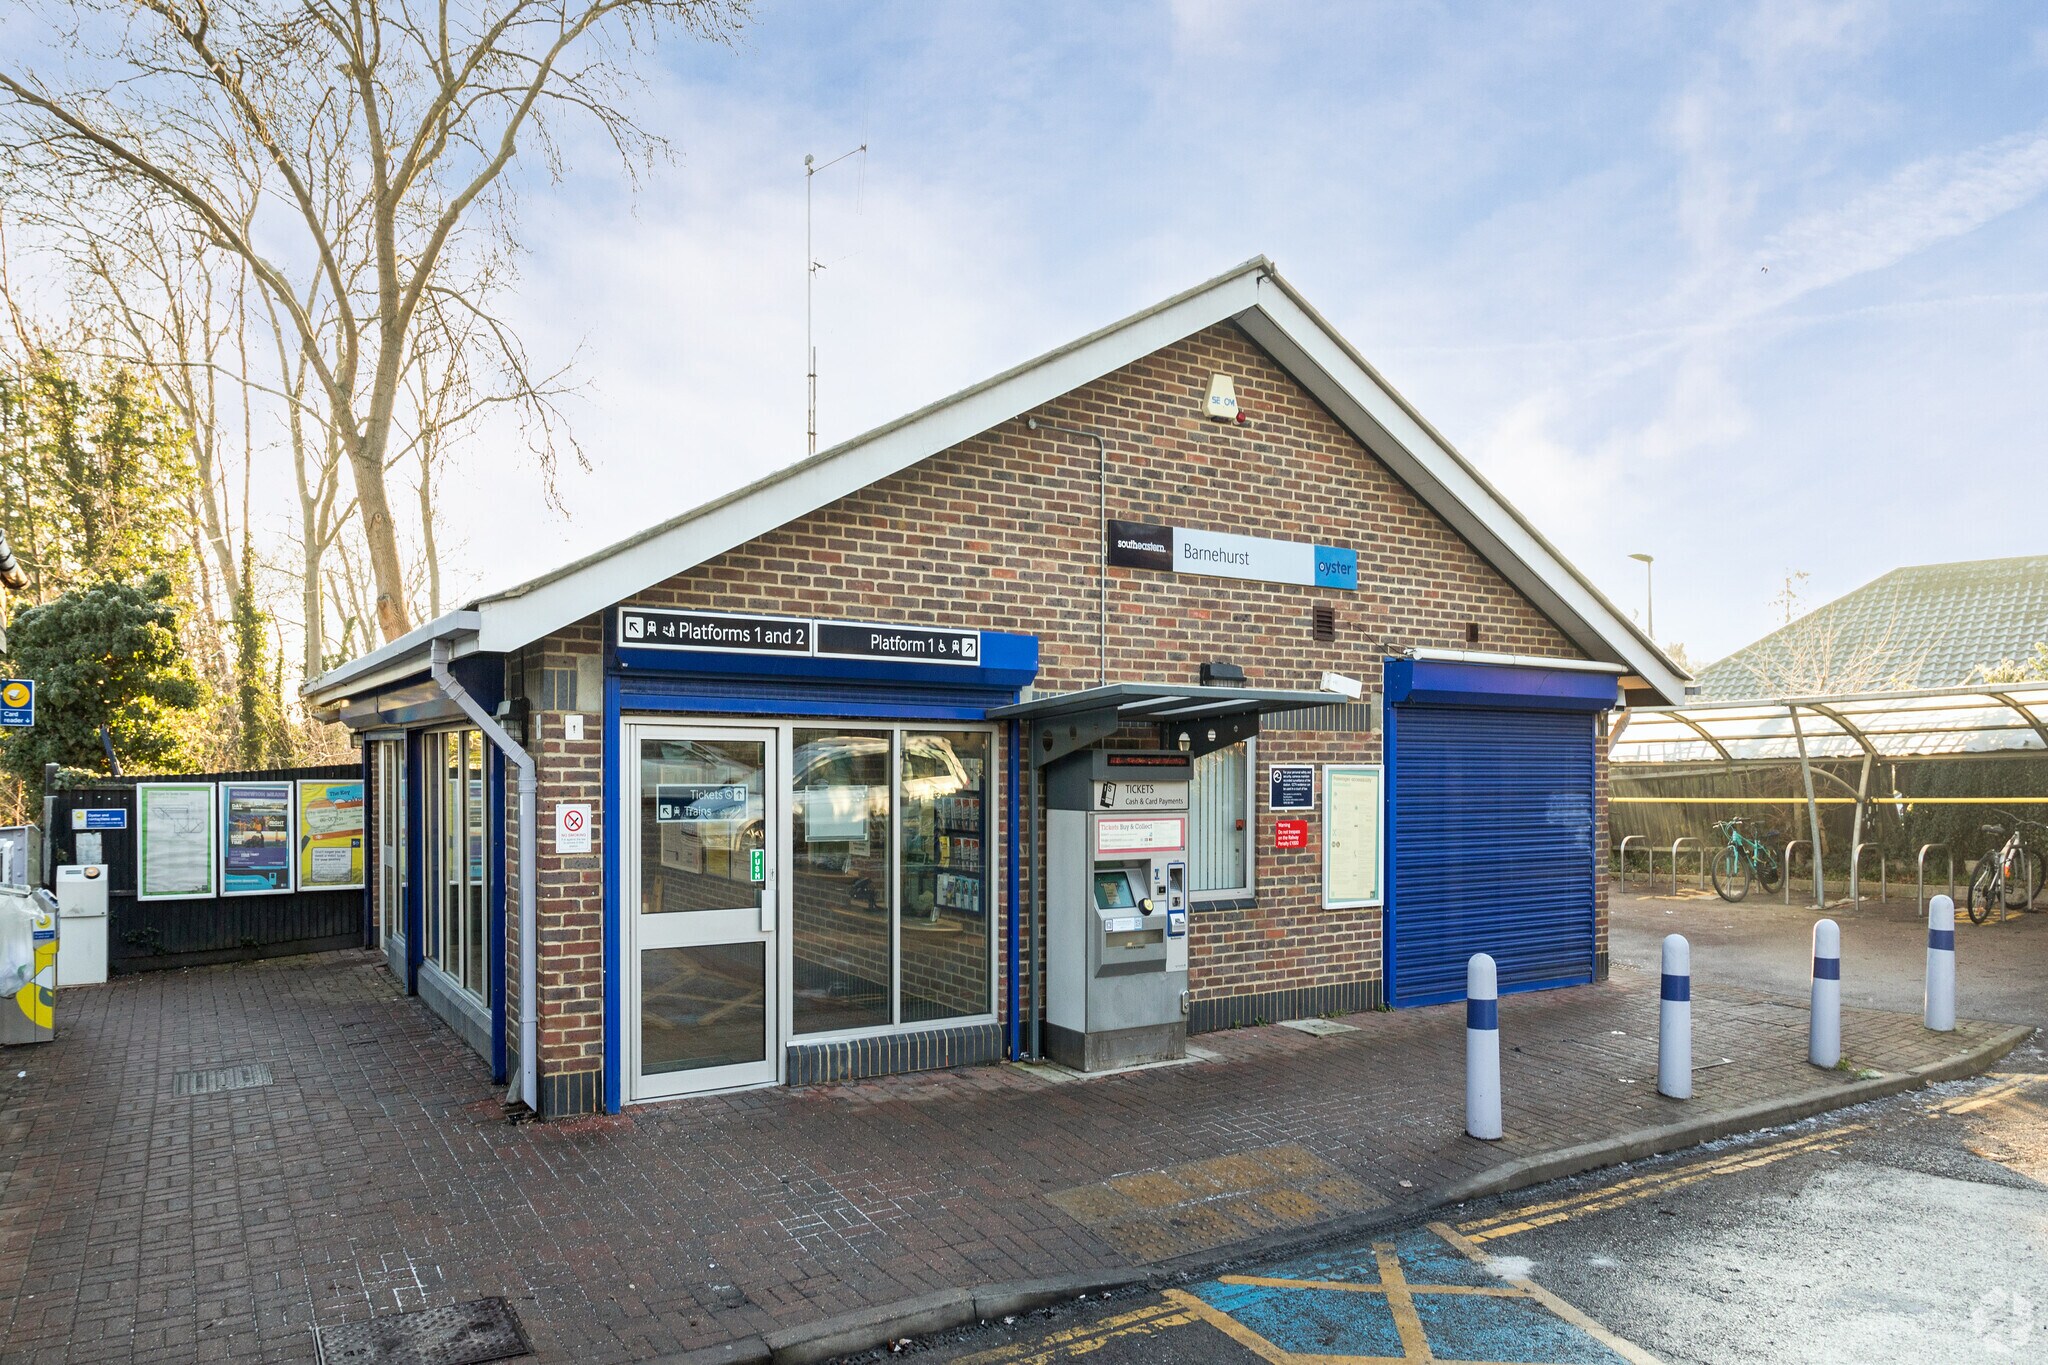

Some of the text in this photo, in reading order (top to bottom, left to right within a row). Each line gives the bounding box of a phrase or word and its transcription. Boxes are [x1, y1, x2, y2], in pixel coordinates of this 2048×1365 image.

[1184, 542, 1250, 566] Barnehurst
[1318, 561, 1352, 576] oyster
[679, 622, 804, 644] Platforms 1 and 2
[870, 634, 934, 652] Platform 1
[690, 790, 723, 800] Tickets
[1126, 784, 1154, 794] TICKETS
[1159, 798, 1184, 806] Payments
[684, 806, 712, 816] Trains
